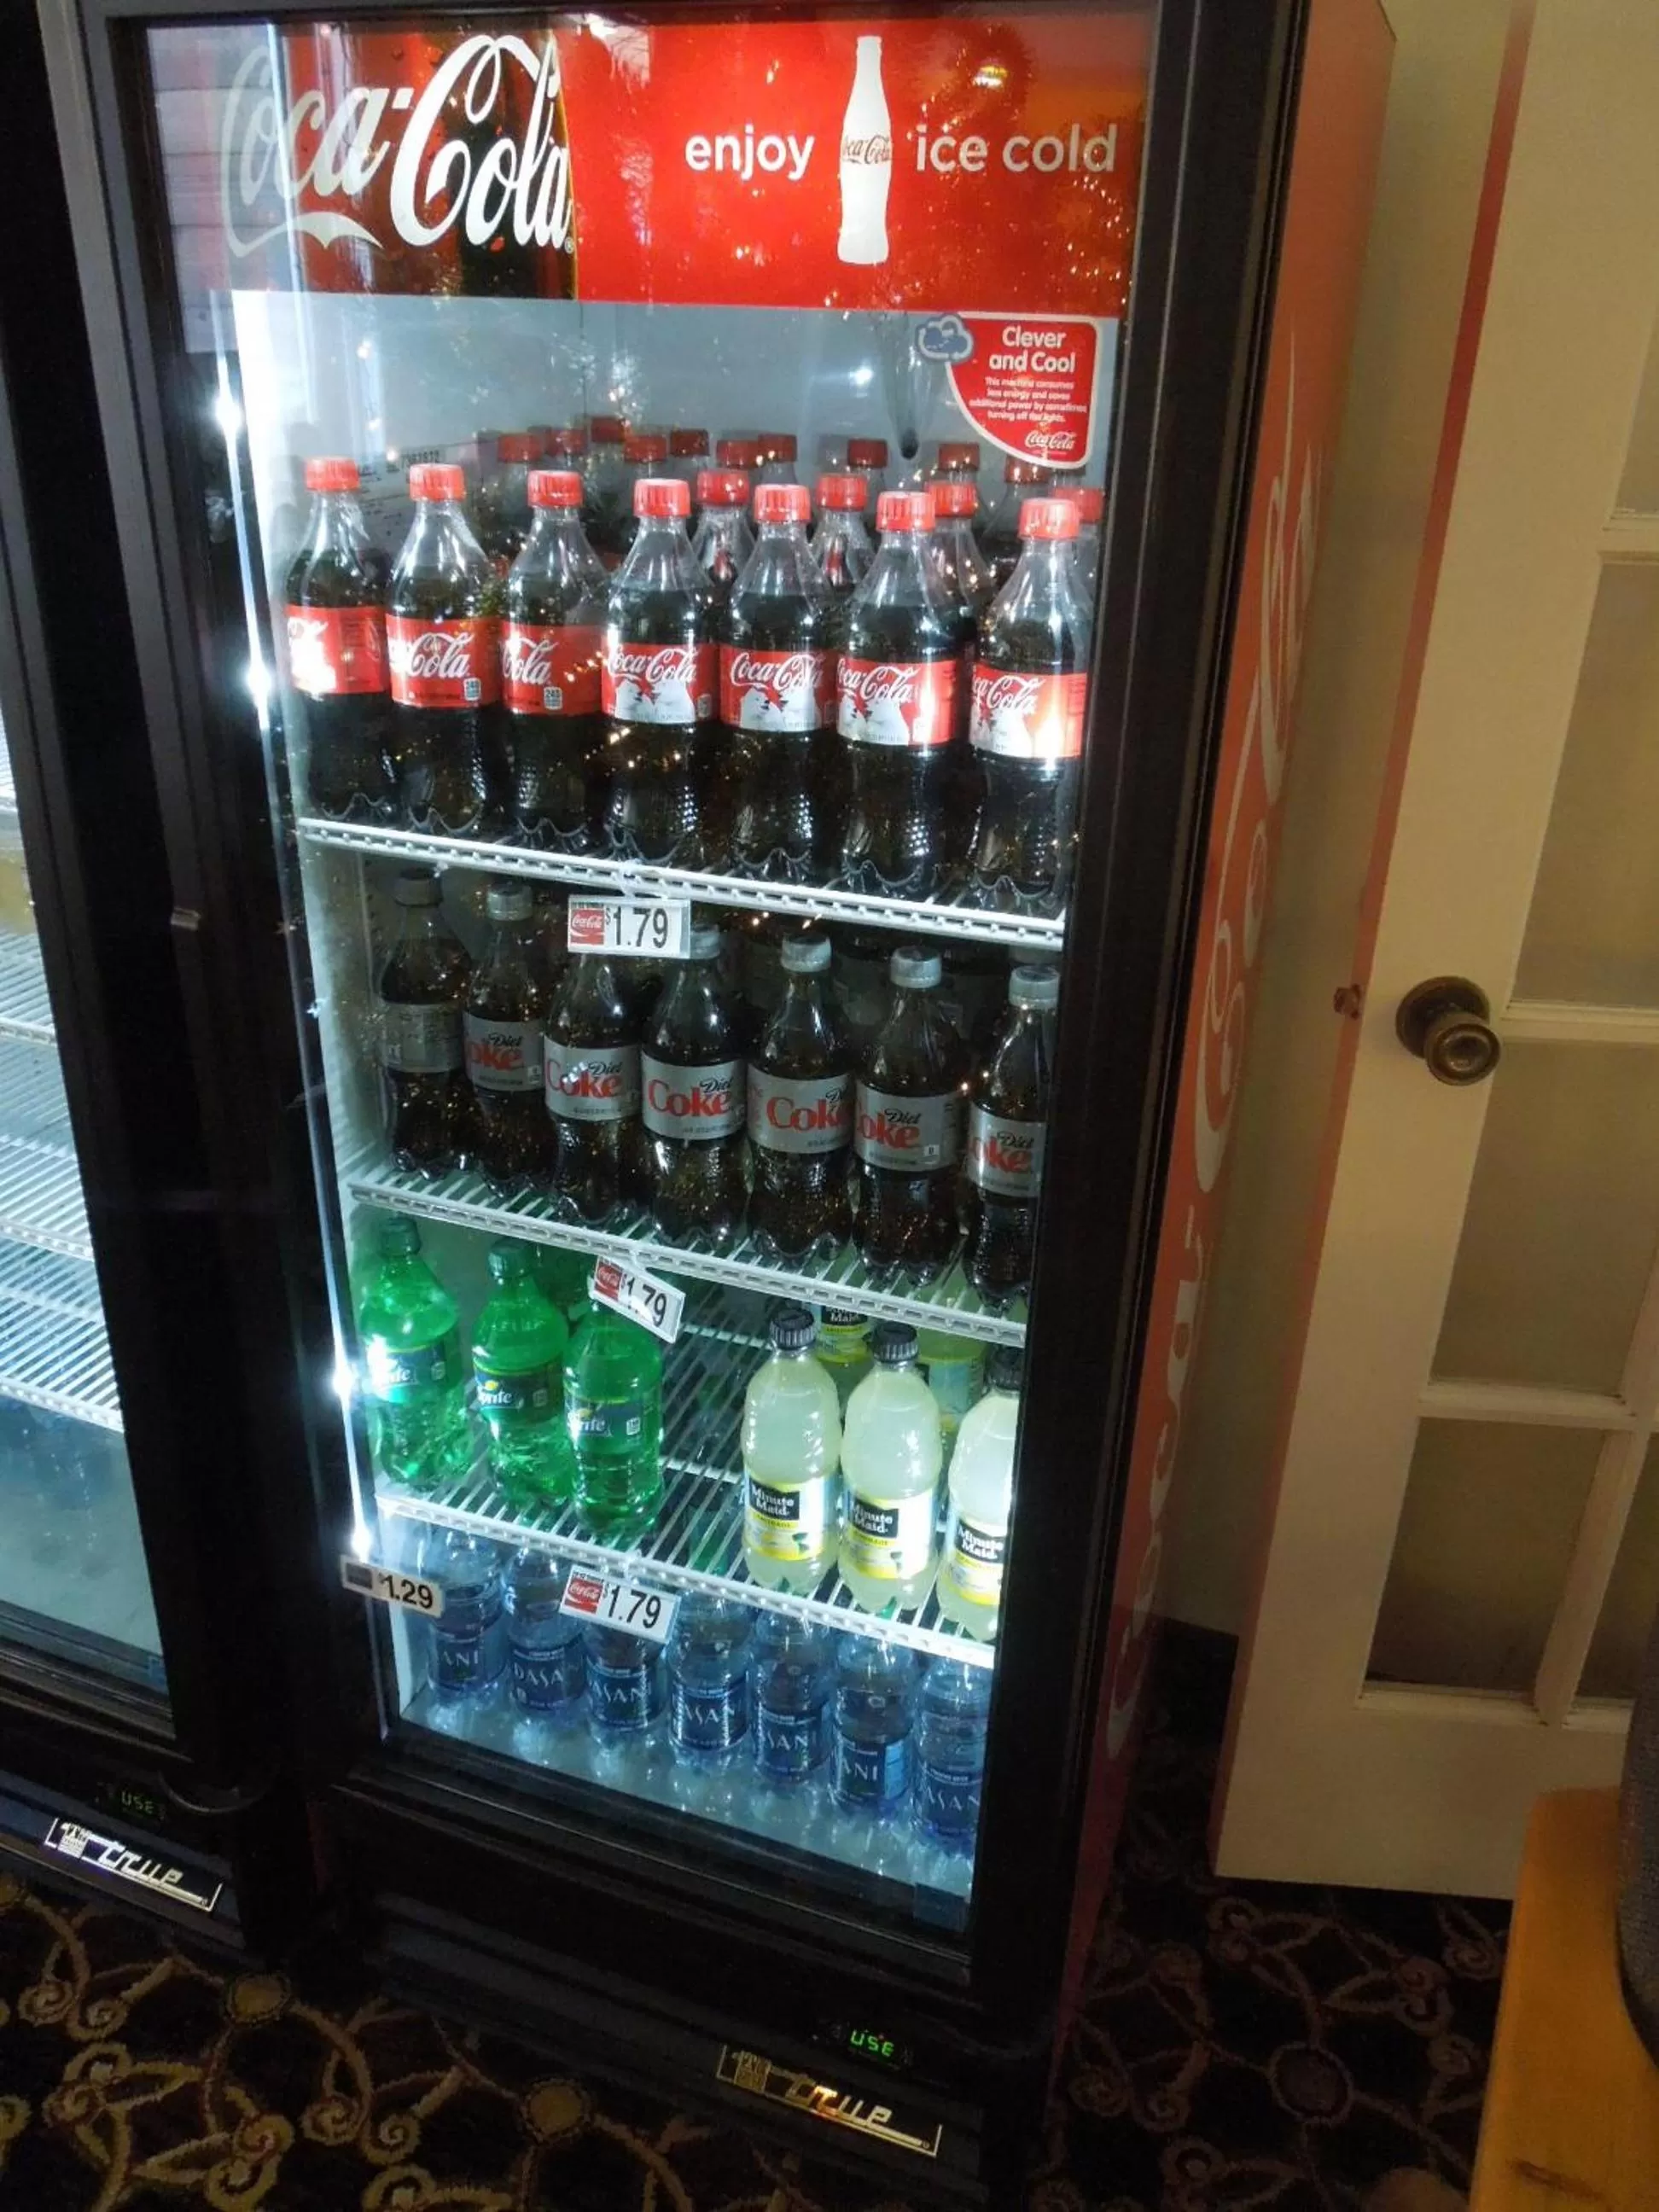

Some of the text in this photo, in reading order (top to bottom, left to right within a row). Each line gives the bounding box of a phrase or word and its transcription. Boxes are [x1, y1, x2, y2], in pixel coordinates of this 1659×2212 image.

[684, 125, 815, 180] enjoy
[916, 123, 1118, 172] ice cold
[1002, 325, 1067, 349] Clever
[989, 351, 1076, 373] and Cool
[985, 376, 1000, 387] This
[1003, 390, 1031, 401] energy
[1032, 391, 1048, 399] and
[1008, 402, 1032, 410] power
[1033, 402, 1045, 412] by
[987, 411, 1016, 422] turning
[1016, 411, 1028, 421] off
[470, 1041, 525, 1071] oke
[546, 1059, 622, 1098] Coke
[649, 1079, 732, 1117] Coke
[884, 1108, 922, 1125] Diet
[969, 1136, 1033, 1173] oke
